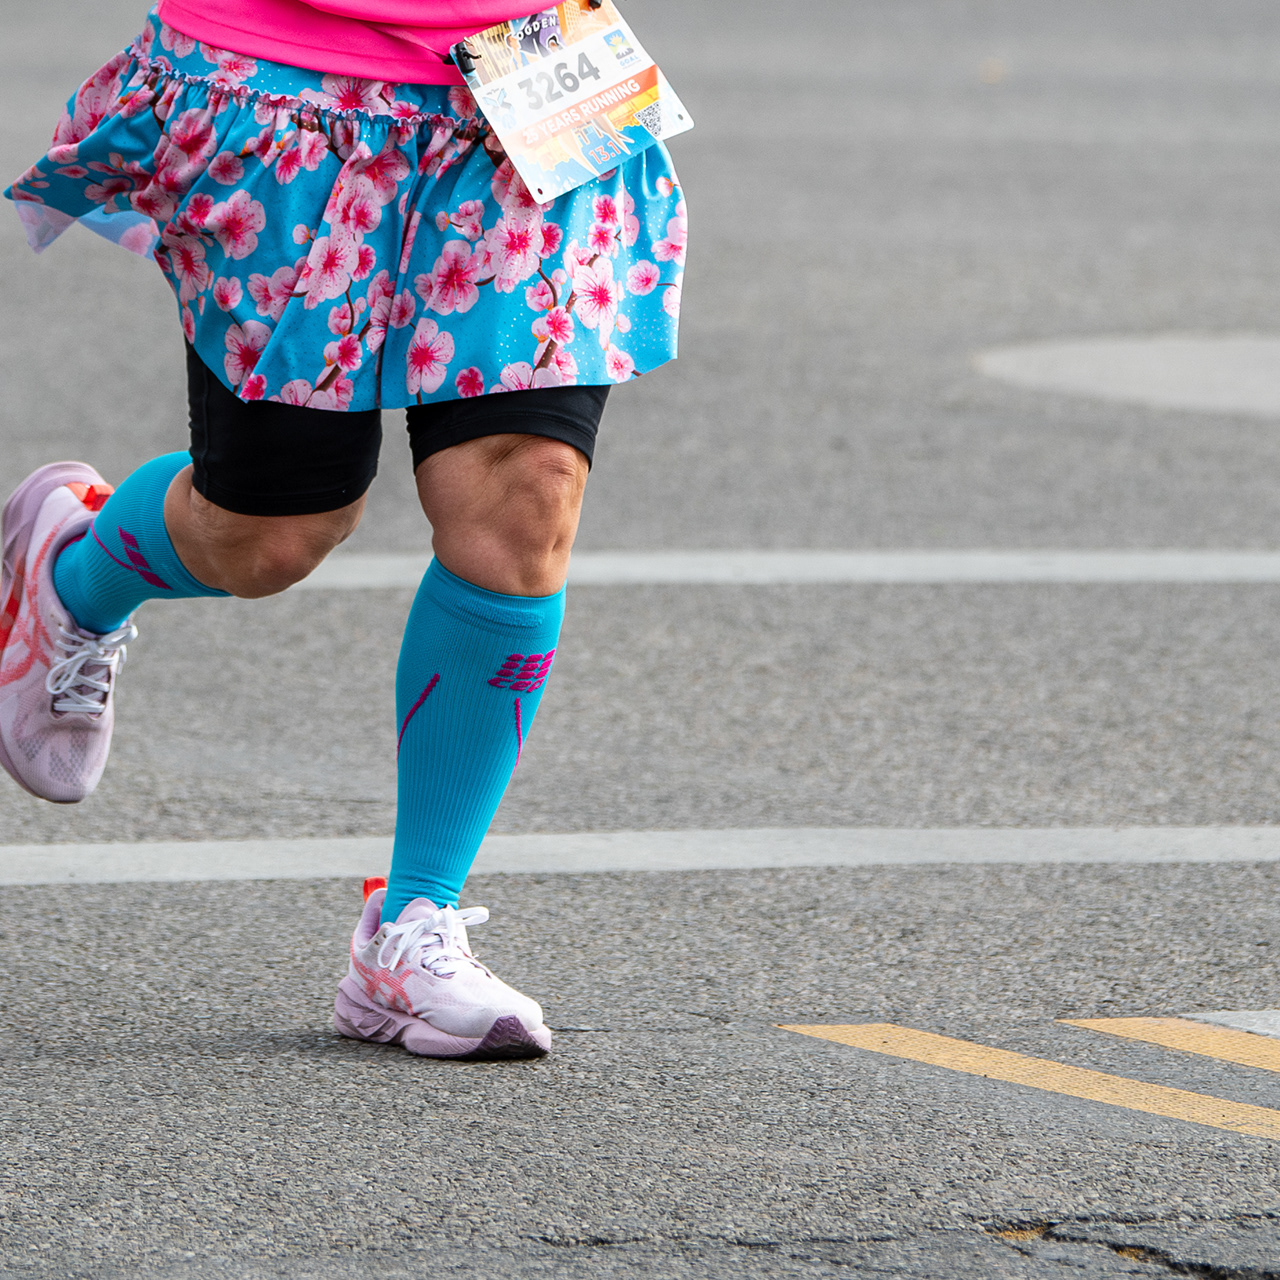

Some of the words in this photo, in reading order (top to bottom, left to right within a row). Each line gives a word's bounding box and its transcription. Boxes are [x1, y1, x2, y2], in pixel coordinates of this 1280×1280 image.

[517, 16, 556, 41] OGDEN
[620, 55, 638, 66] GOAL
[517, 52, 601, 110] 3264
[523, 127, 539, 144] 25
[538, 108, 580, 136] YEARS
[579, 79, 640, 117] RUNNING
[589, 141, 620, 164] 13.1
